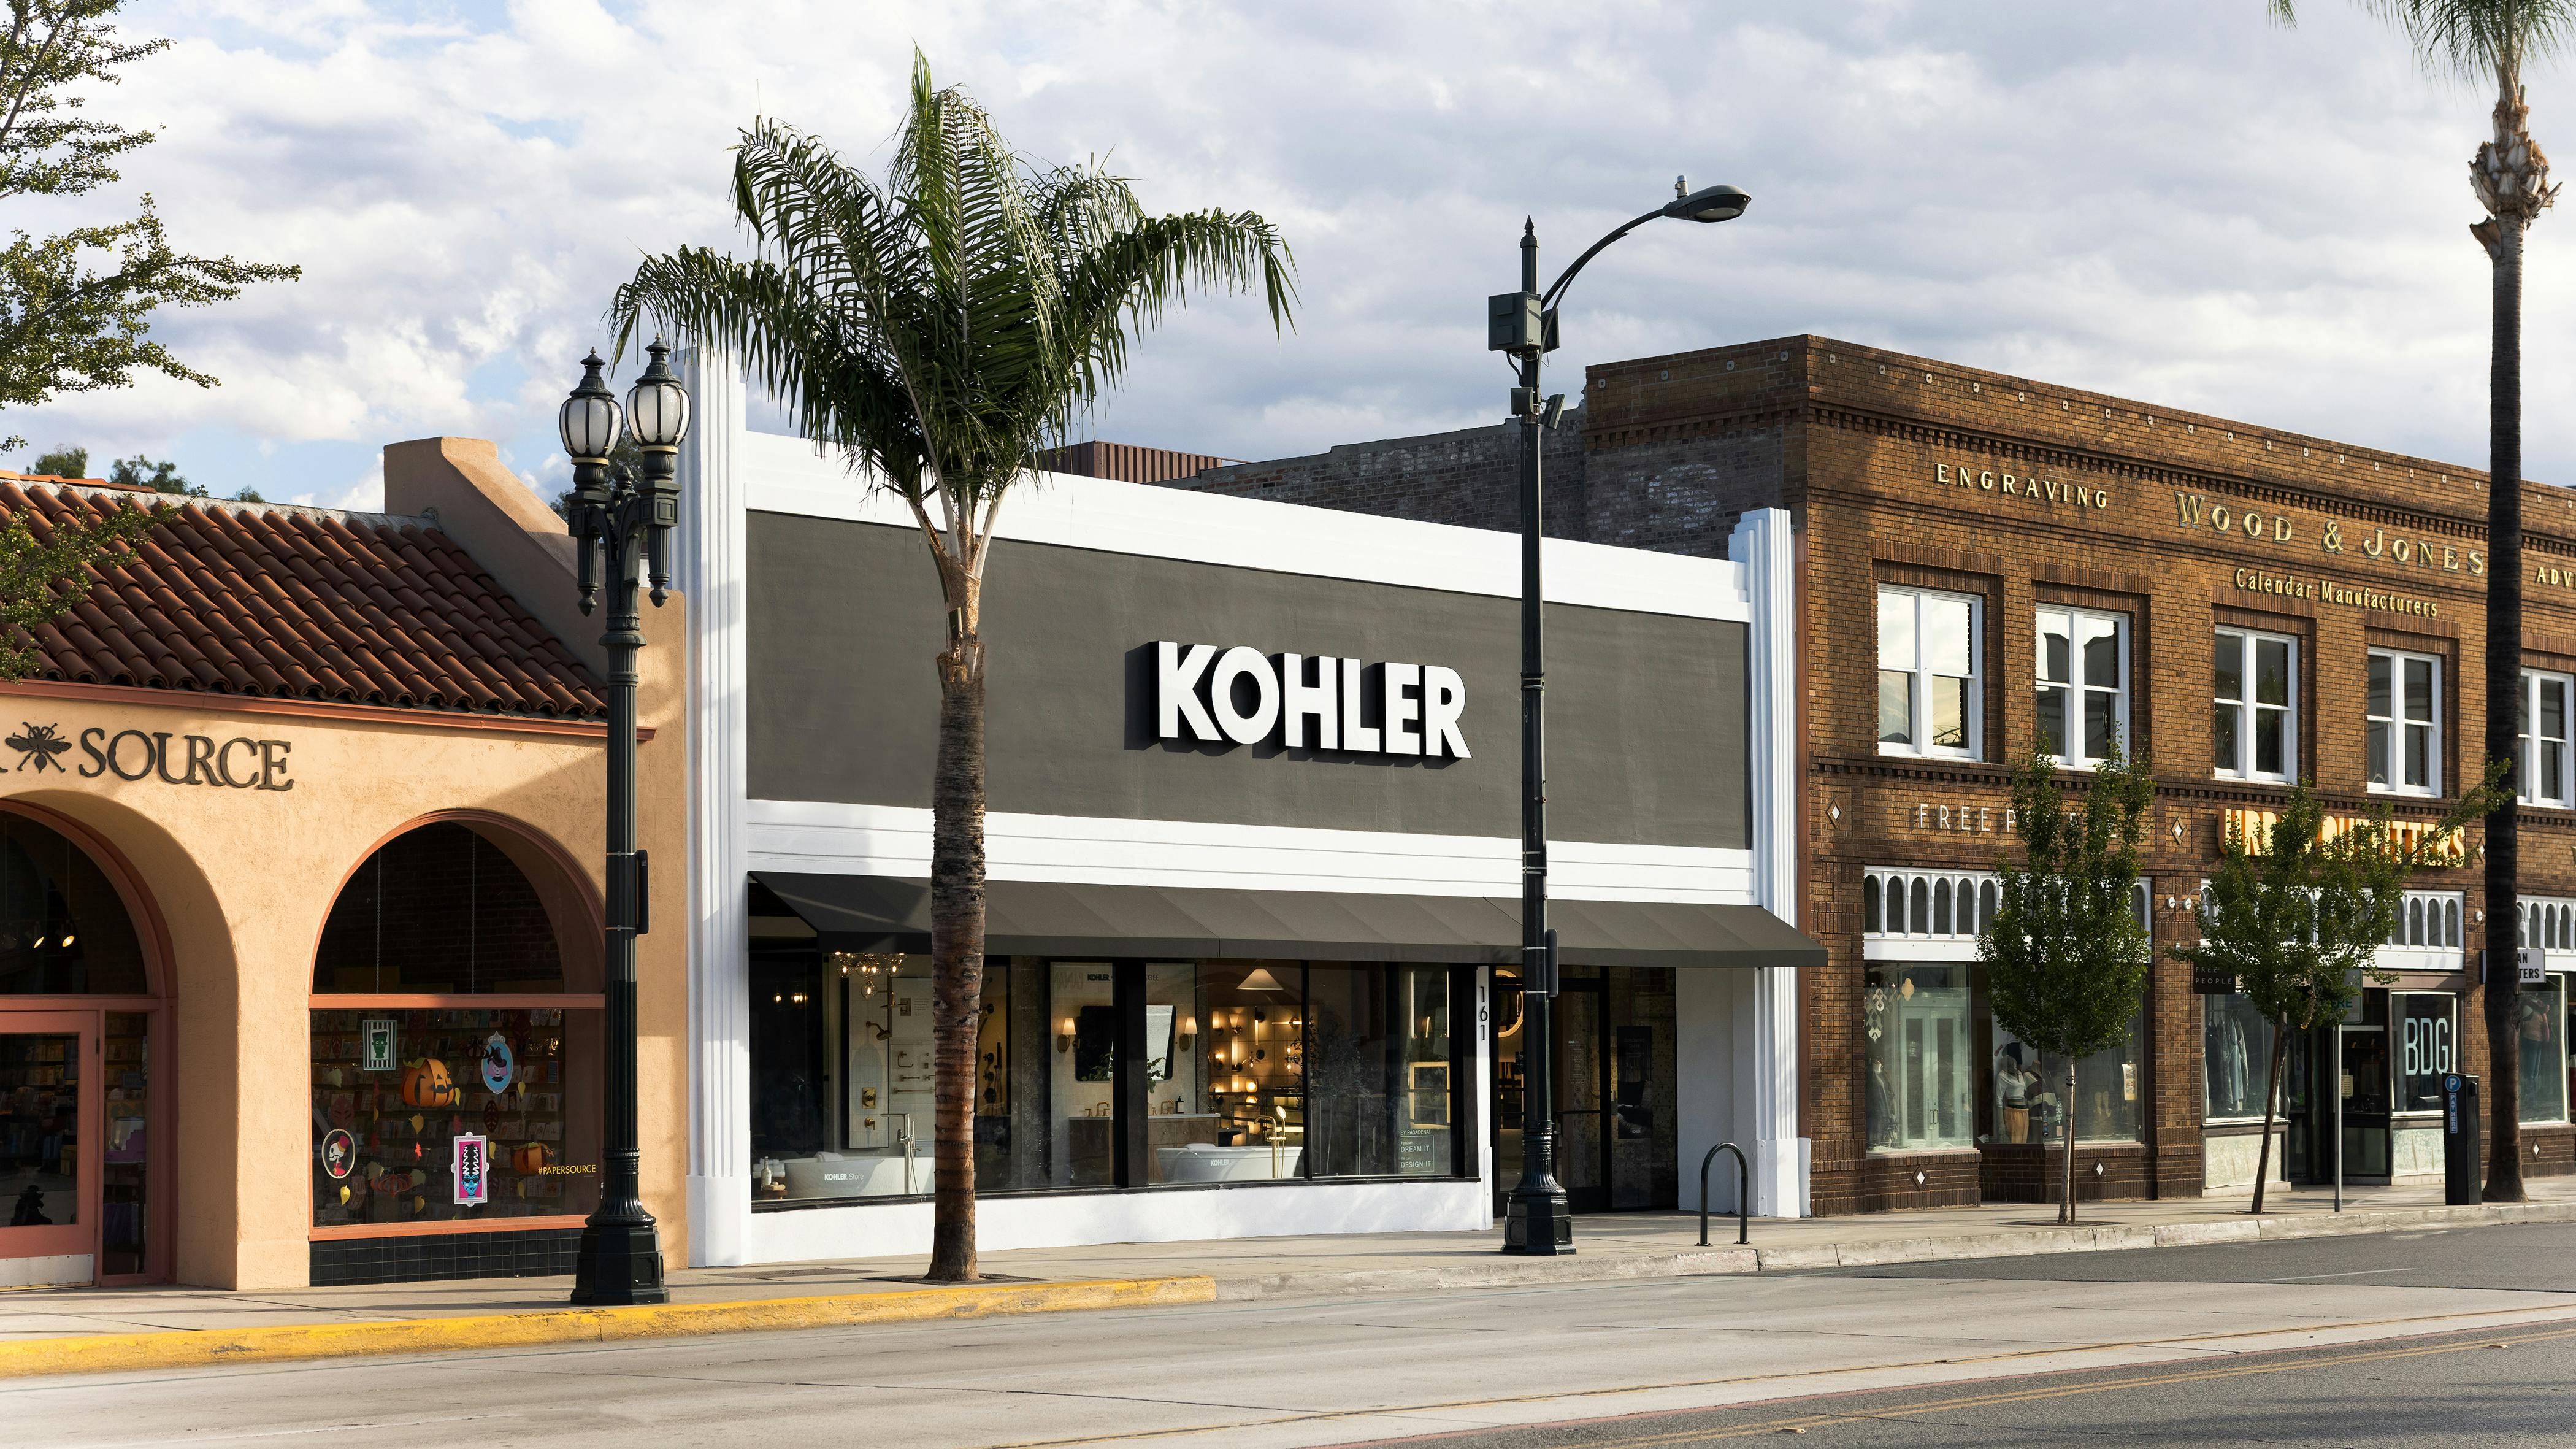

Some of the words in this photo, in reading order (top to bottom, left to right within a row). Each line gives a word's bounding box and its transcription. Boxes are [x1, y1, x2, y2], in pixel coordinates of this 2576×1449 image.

[1935, 463, 2107, 508] ENGRAVING
[2175, 491, 2292, 543] WOOD
[2322, 520, 2343, 553] &
[2363, 528, 2483, 575] JONES
[2234, 567, 2312, 598] Calendar
[2321, 580, 2438, 617] Manufacturers
[2536, 566, 2576, 590] ADV
[1158, 640, 1473, 758] KOHLER
[79, 727, 294, 791] SOURCE
[1920, 804, 1990, 831] FREE
[2219, 809, 2312, 856] URB
[1479, 986, 1488, 1040] 161
[2405, 1018, 2448, 1075] BDG
[2450, 1078, 2457, 1089] P
[538, 1164, 596, 1175] #PAPERSOURCE
